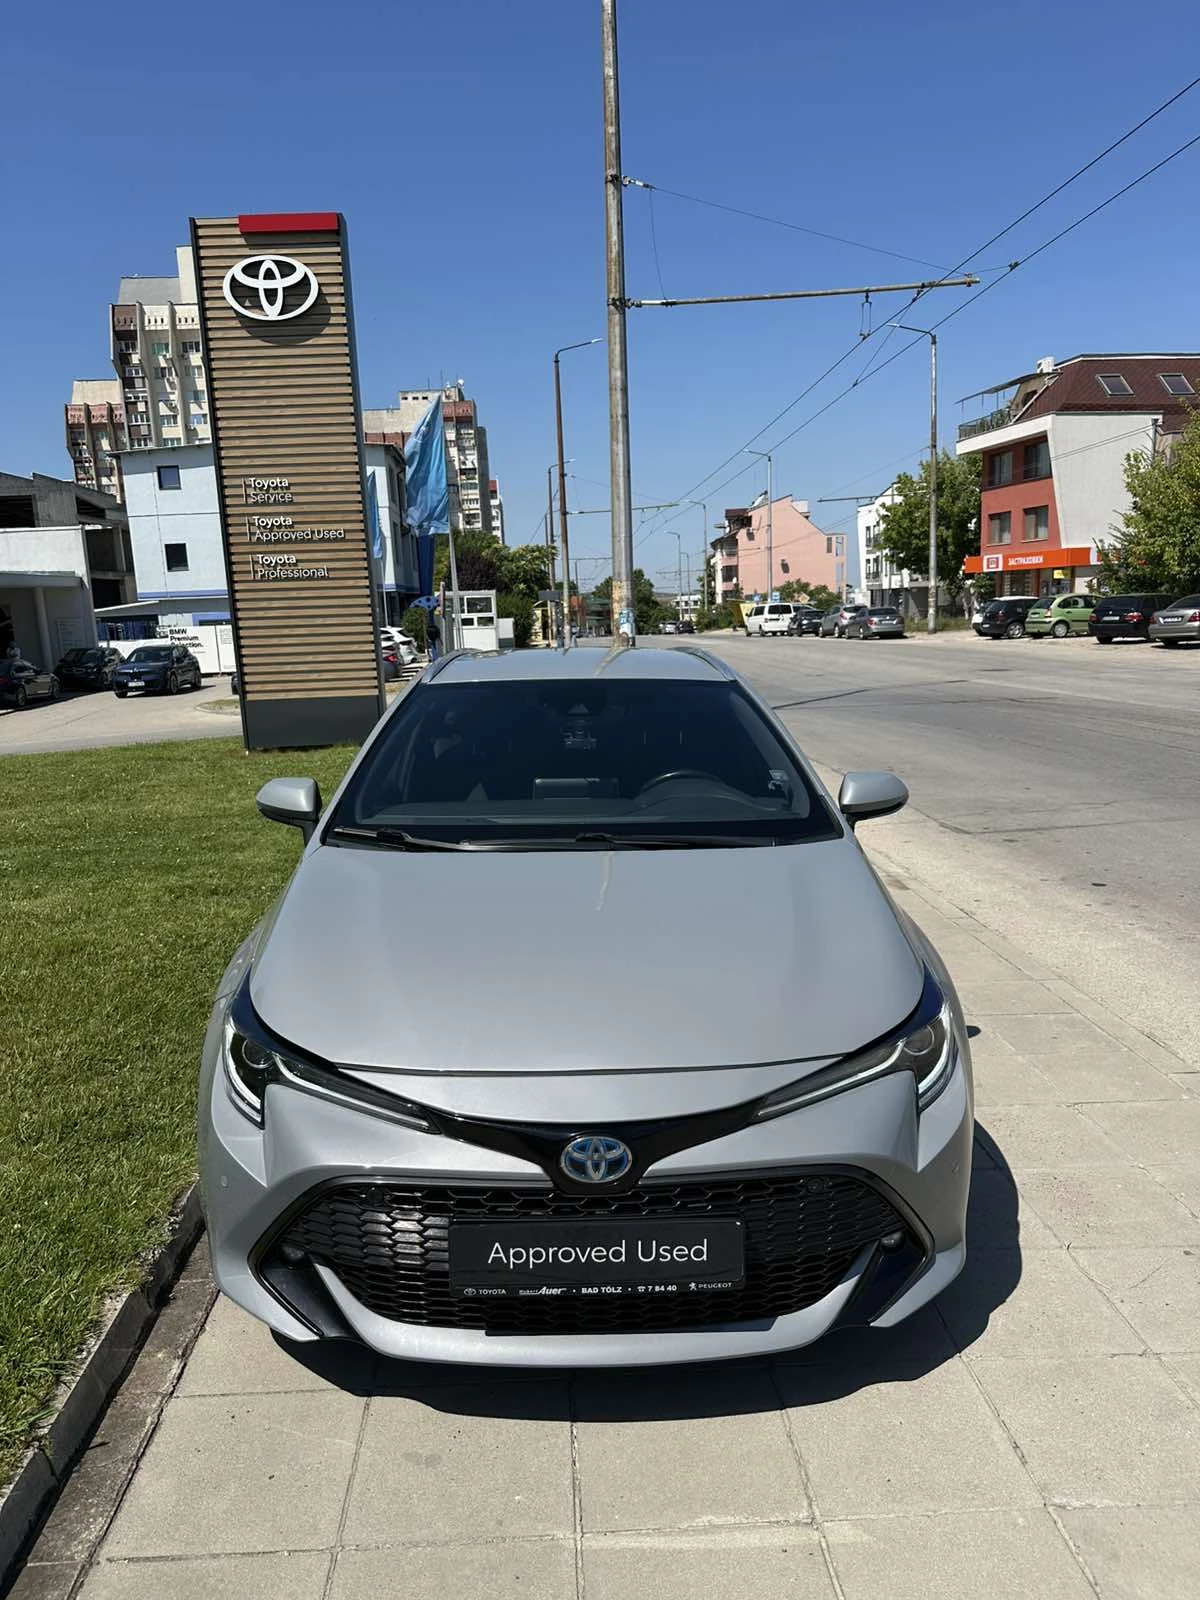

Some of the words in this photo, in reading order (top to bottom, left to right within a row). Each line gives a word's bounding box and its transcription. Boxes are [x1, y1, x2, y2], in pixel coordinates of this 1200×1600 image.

[249, 477, 289, 489] Toyota
[250, 491, 292, 502] Service
[253, 515, 293, 528] Toyota
[254, 528, 312, 541] Approved
[315, 528, 345, 539] Used
[257, 554, 297, 566] Toyota
[258, 565, 328, 578] Professional
[488, 1240, 626, 1269] Approved
[637, 1238, 708, 1262] Used
[600, 1285, 623, 1293] TÖLZ
